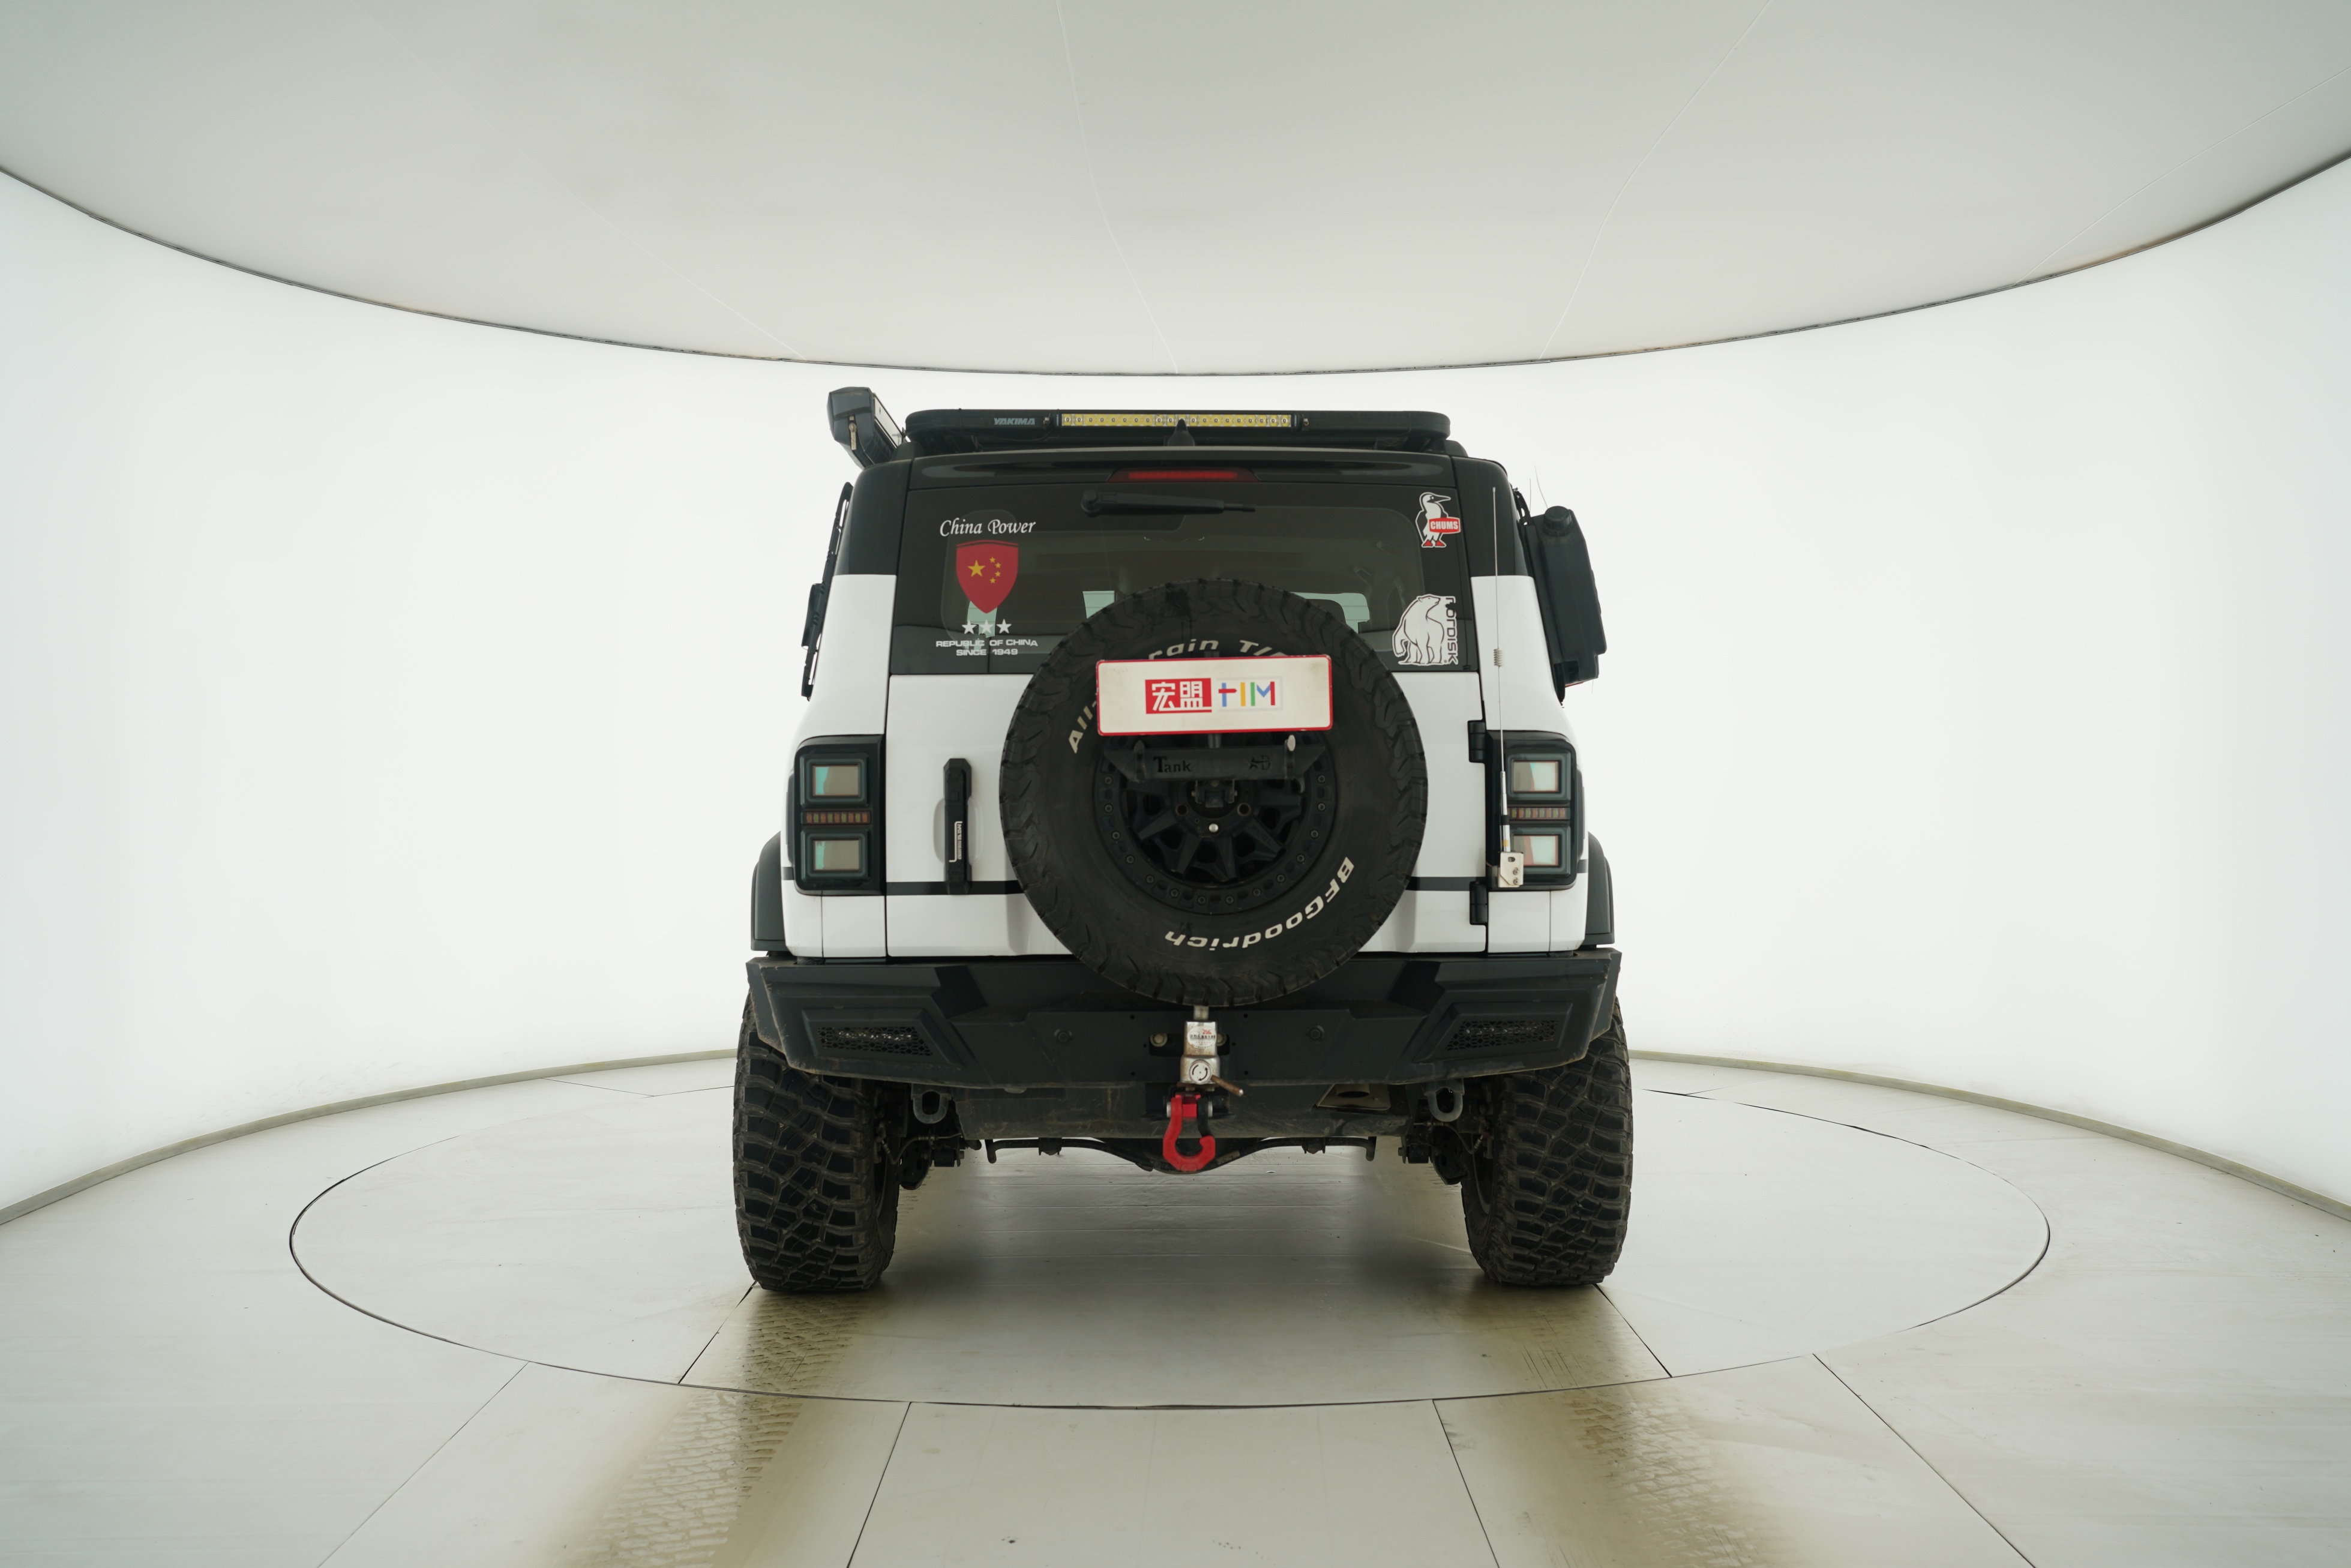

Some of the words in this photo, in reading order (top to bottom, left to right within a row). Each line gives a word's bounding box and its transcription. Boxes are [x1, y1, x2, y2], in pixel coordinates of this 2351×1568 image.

[940, 517, 982, 536] China
[988, 519, 1036, 535] Power
[1430, 521, 1459, 530] CHUMS
[1151, 682, 1209, 711] 宏盟
[1153, 756, 1192, 773] Tank
[1165, 857, 1354, 951] BFGoodrich
